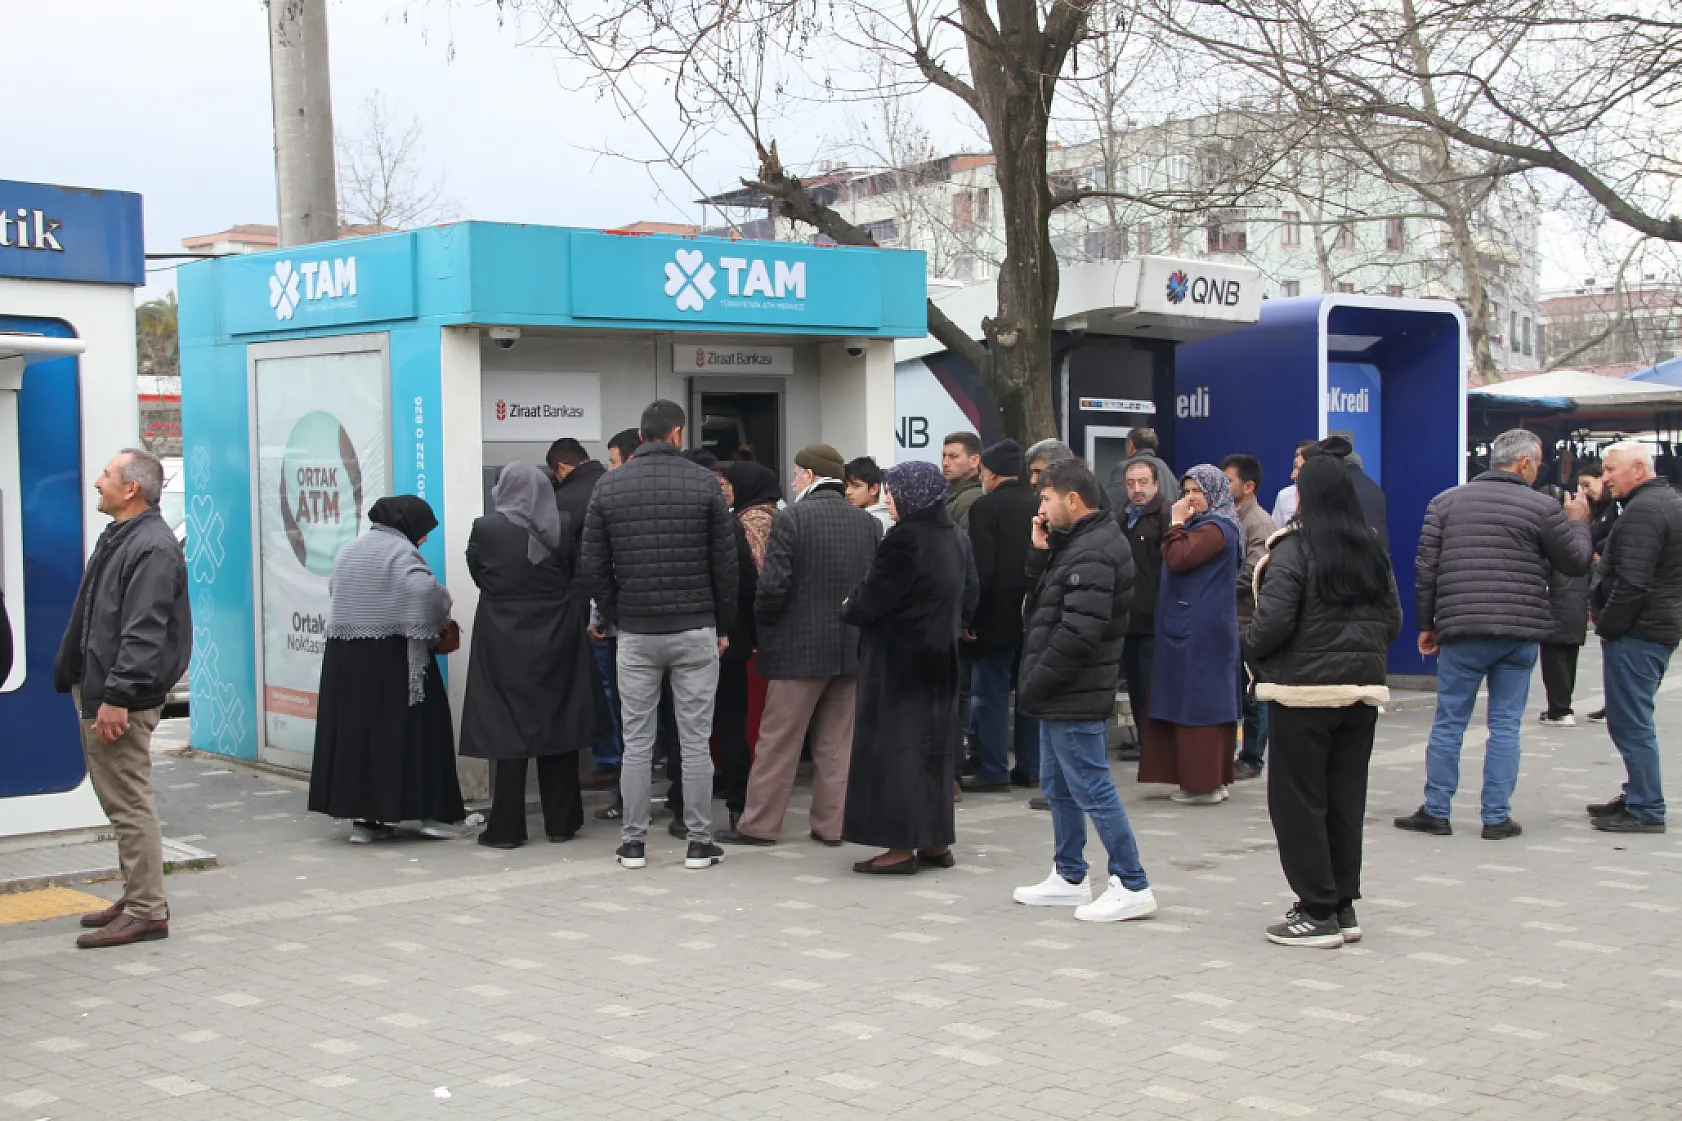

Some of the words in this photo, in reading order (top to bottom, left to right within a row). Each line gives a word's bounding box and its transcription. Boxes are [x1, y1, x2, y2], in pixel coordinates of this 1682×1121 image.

[300, 256, 358, 300] TAM
[720, 257, 806, 299] TAM
[1191, 276, 1240, 306] QNB
[708, 352, 735, 365] Ziraat
[737, 352, 773, 365] Bankası
[509, 403, 541, 418] Ziraat
[543, 404, 584, 418] Bankası
[297, 467, 338, 487] ORTAK
[296, 490, 341, 524] ATM
